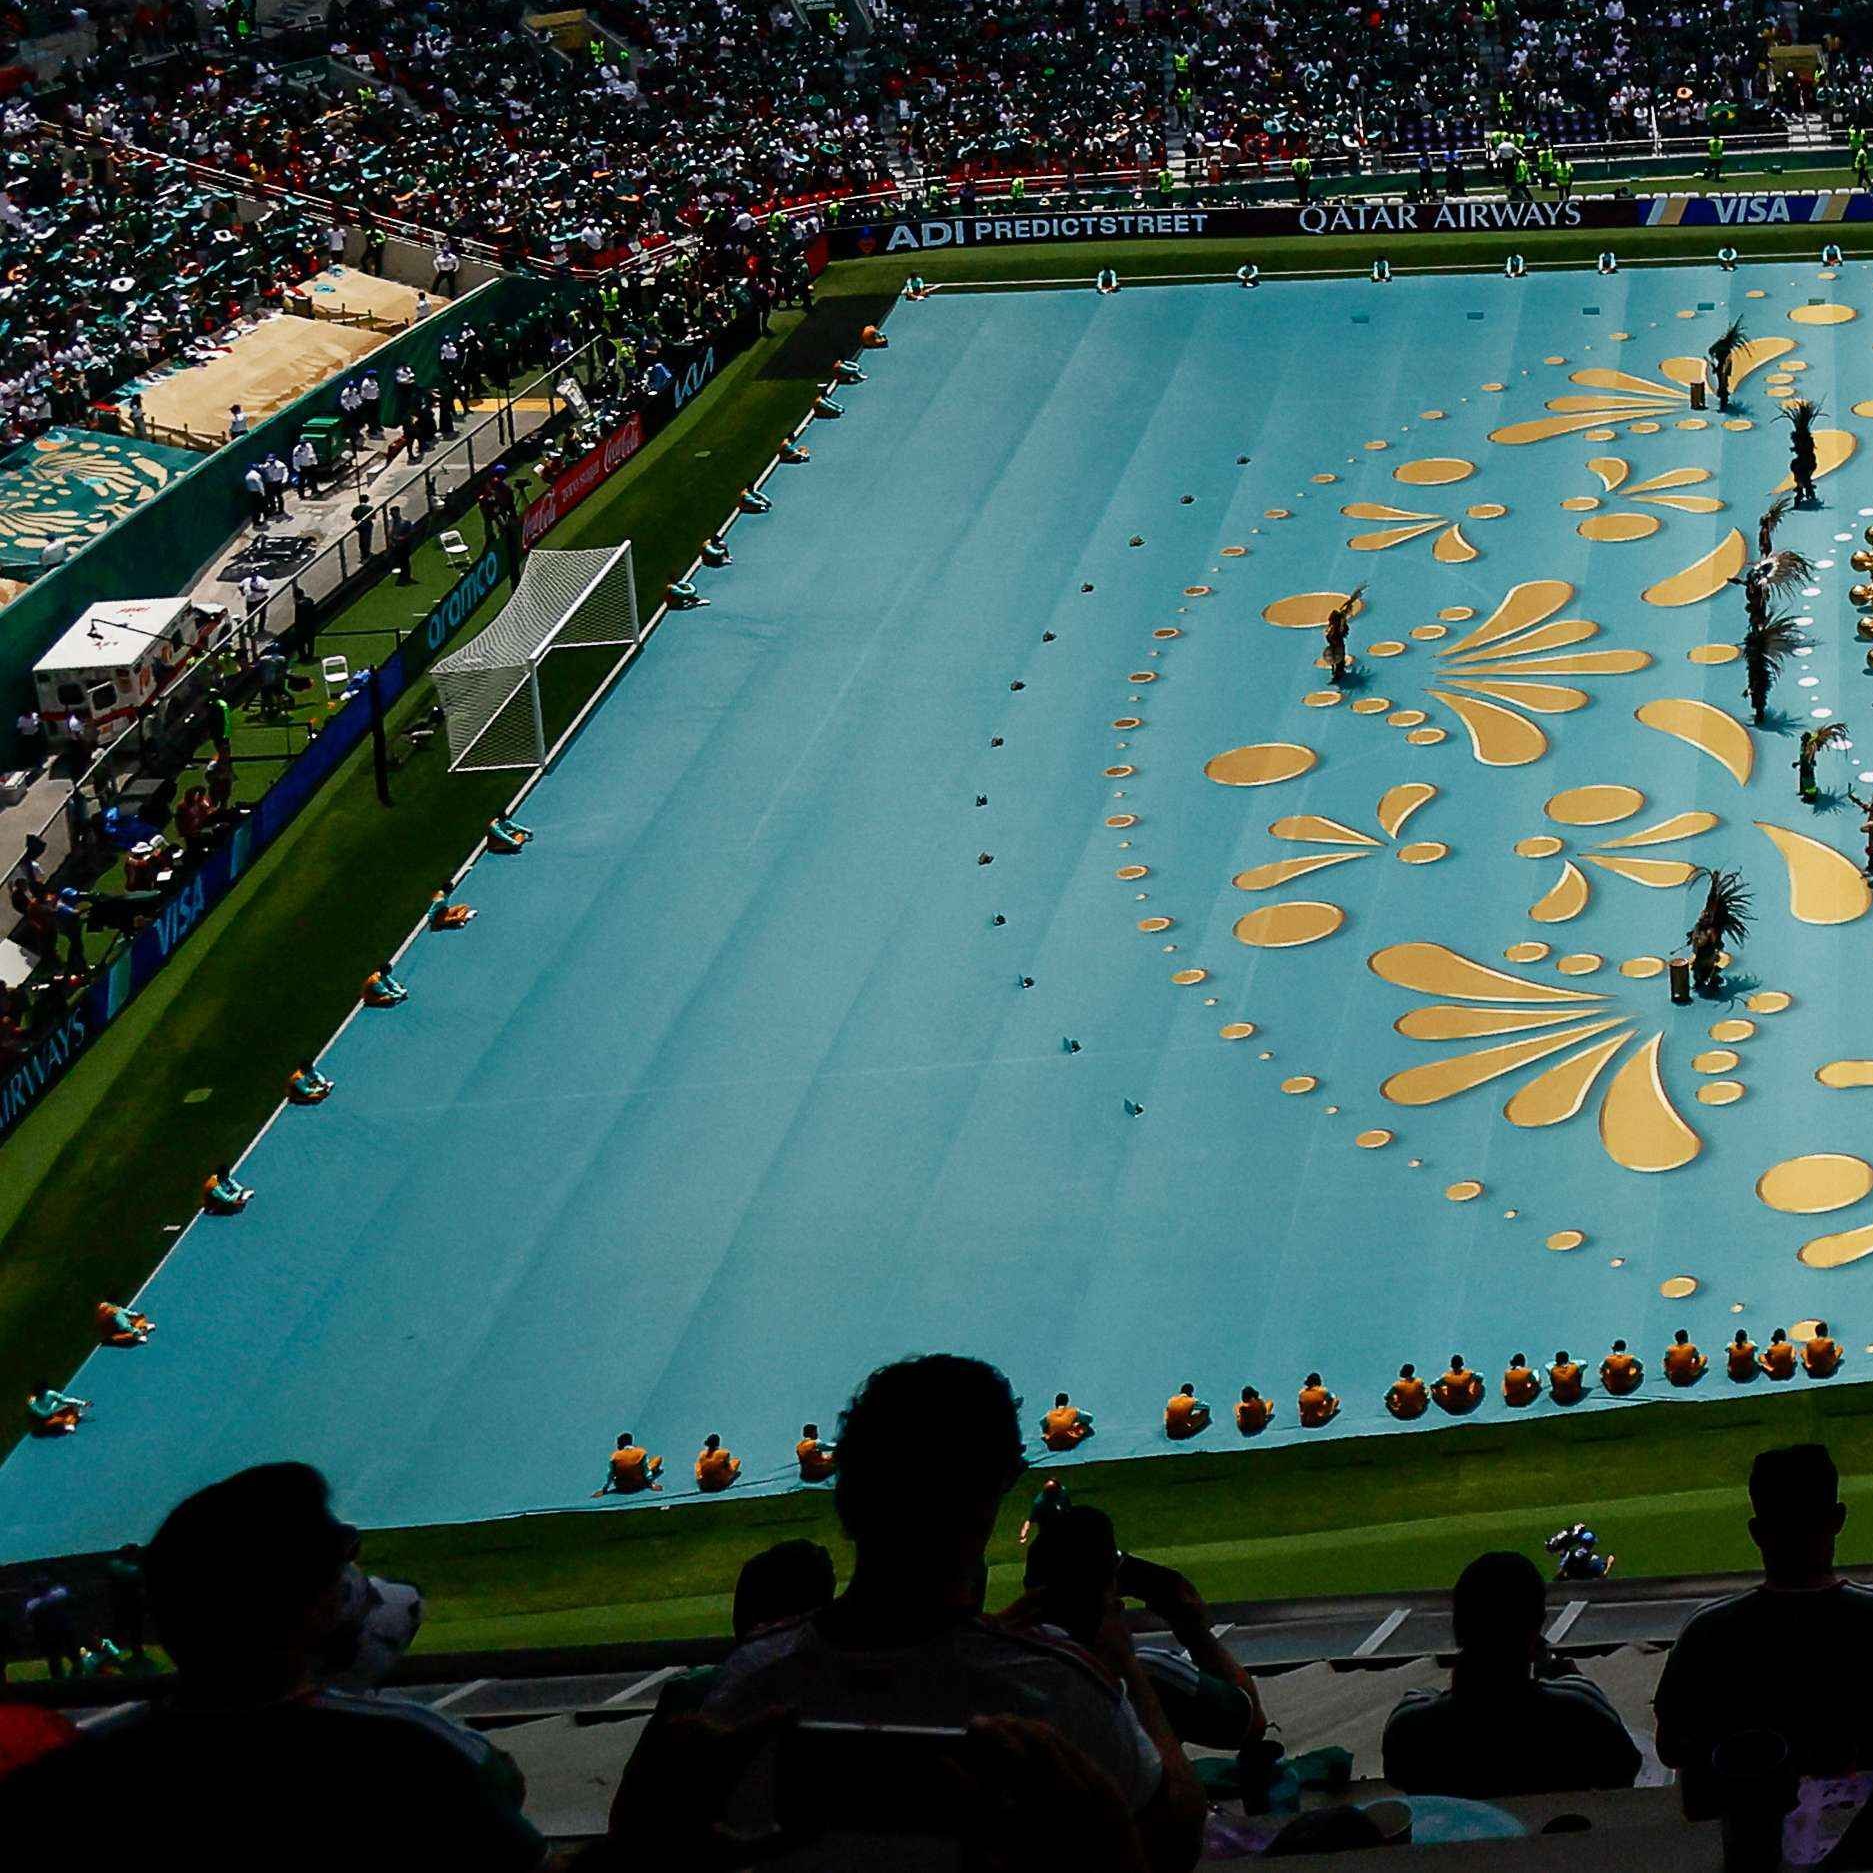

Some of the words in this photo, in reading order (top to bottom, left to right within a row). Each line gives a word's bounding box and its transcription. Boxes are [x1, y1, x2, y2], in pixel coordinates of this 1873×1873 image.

[1298, 201, 1418, 234] QATAR
[1433, 199, 1583, 230] AIRWAYS
[1711, 195, 1792, 225] VISA
[885, 220, 965, 252] ADI
[974, 213, 1209, 242] PREDICTSTREET
[425, 550, 499, 651] aramco
[152, 874, 206, 957] VISA
